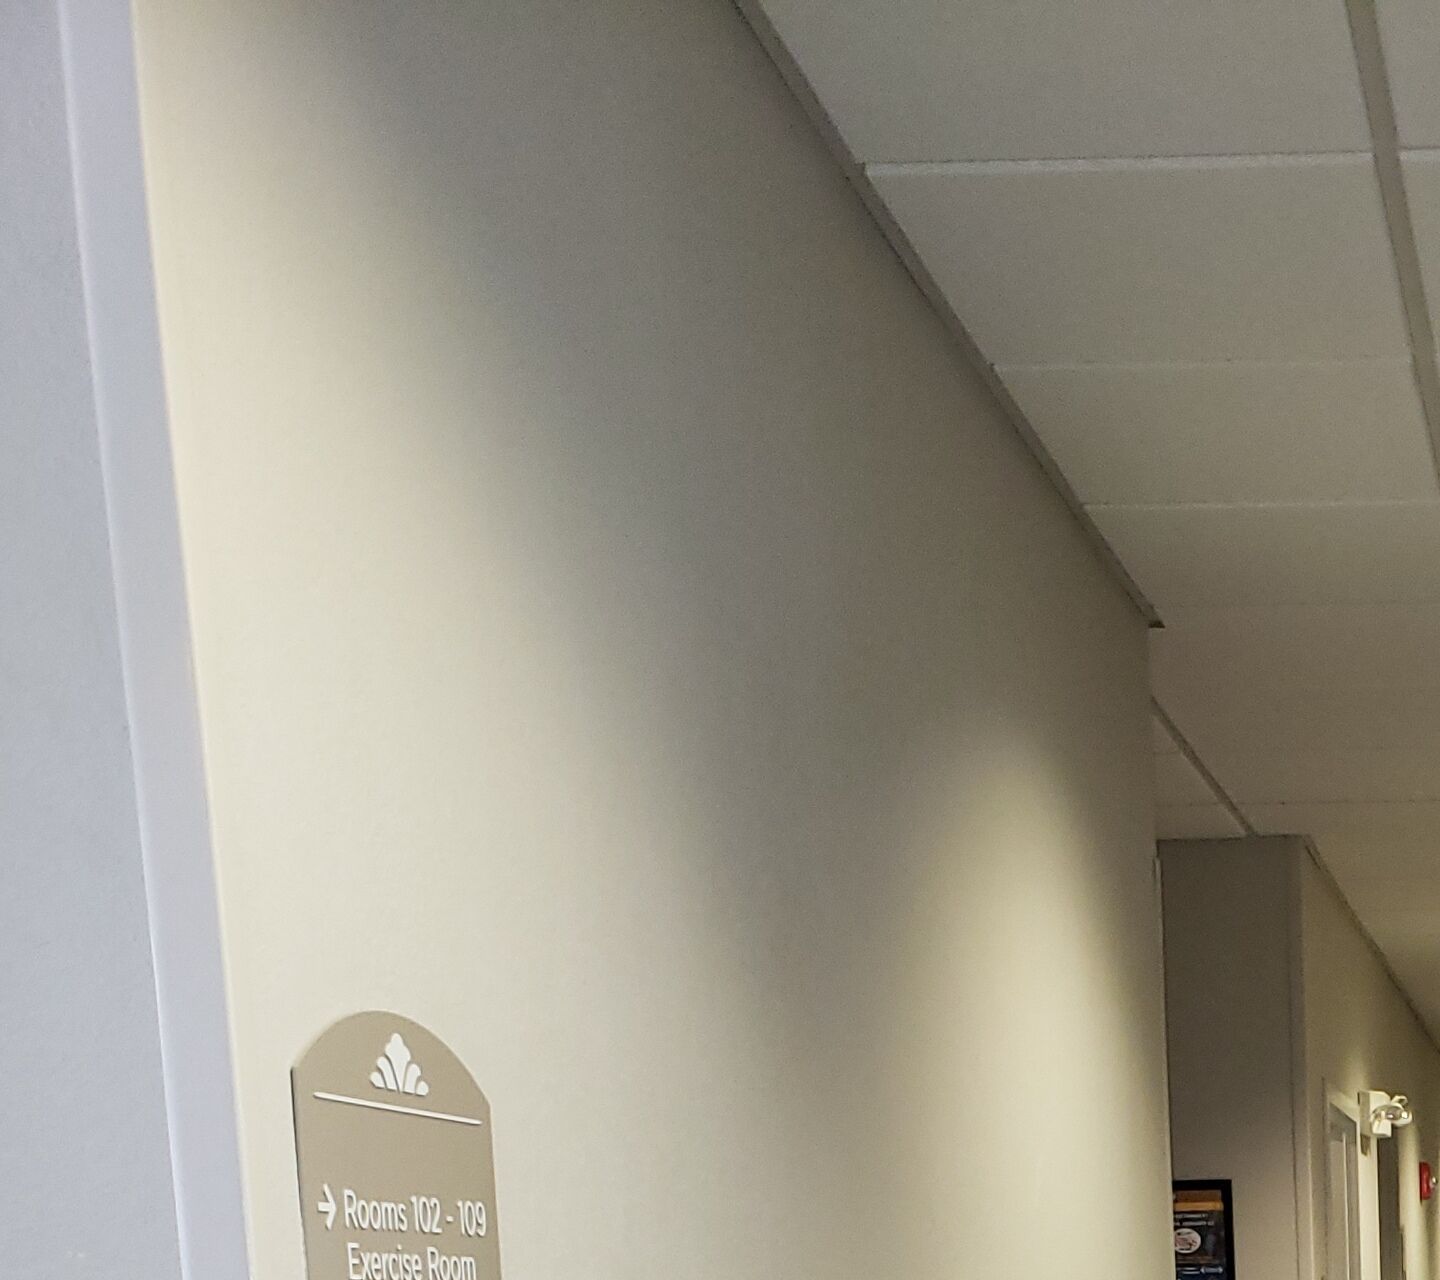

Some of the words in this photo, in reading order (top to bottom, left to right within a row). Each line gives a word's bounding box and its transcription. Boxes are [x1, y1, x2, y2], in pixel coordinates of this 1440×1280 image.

[343, 1188, 408, 1232] Rooms
[410, 1195, 443, 1234] 102
[457, 1200, 487, 1237] 109
